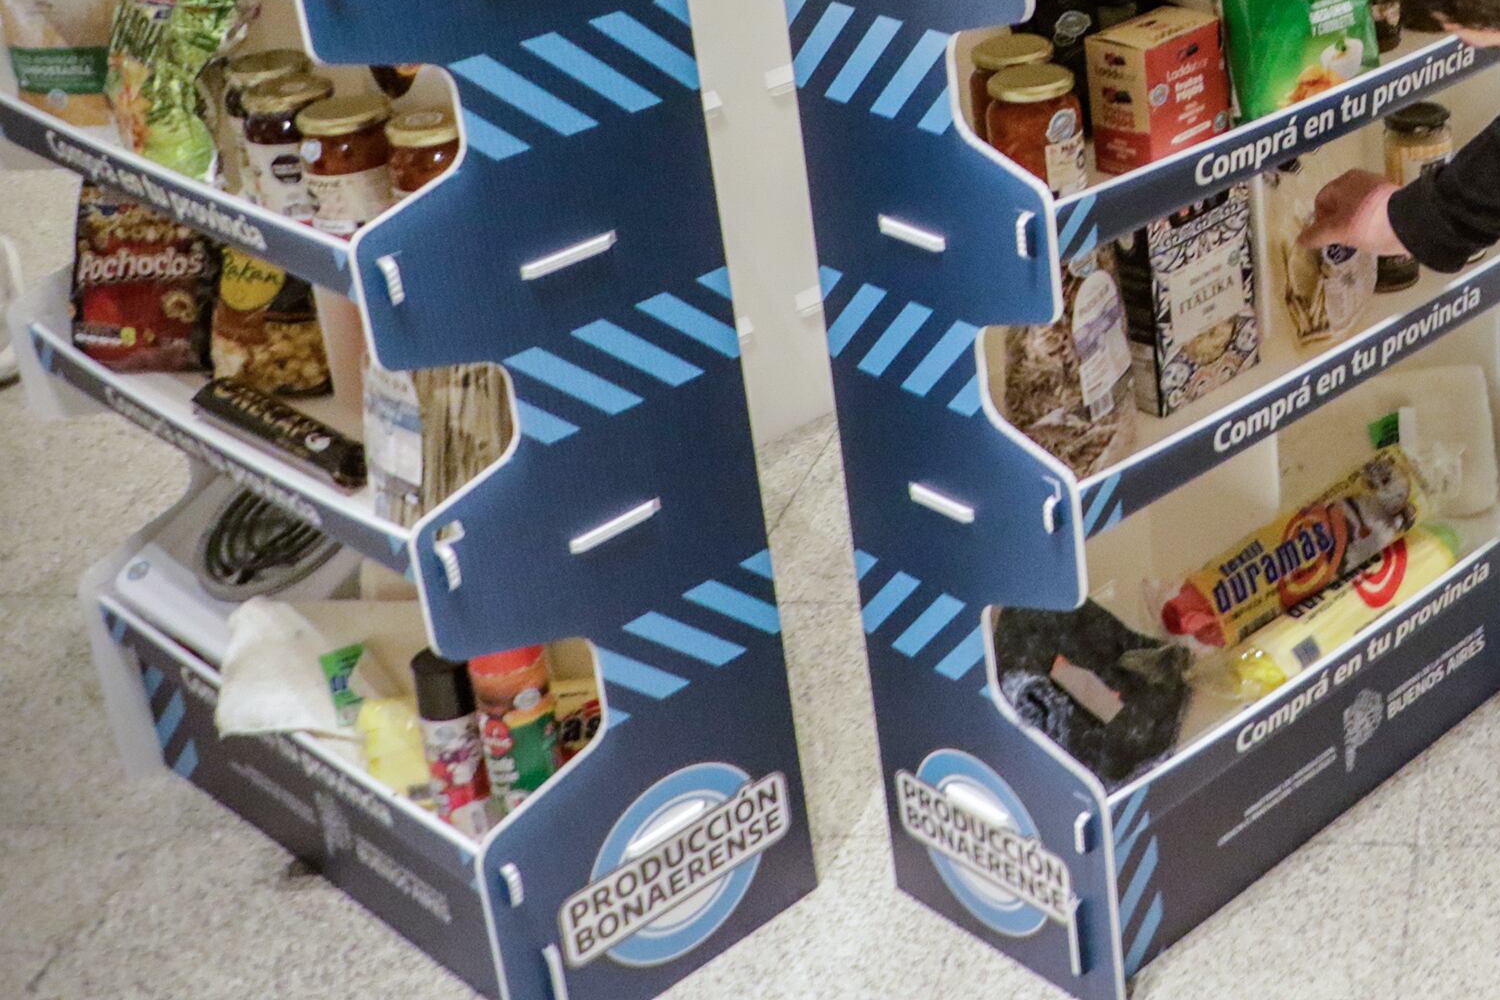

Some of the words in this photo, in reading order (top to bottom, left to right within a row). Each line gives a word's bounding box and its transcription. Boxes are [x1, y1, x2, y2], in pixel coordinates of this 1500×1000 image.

[1194, 120, 1298, 187] Comprá
[1304, 109, 1334, 139] en
[1340, 92, 1368, 122] tu
[1374, 43, 1476, 115] provincia
[168, 189, 268, 251] provincia
[1213, 381, 1311, 454] Comprá
[1315, 362, 1345, 395] en
[1350, 343, 1378, 374] tu
[1382, 287, 1481, 367] provincia
[1236, 671, 1328, 753] Comprá
[1333, 651, 1362, 689] en
[1366, 632, 1392, 665] tu
[1394, 560, 1490, 649] provincia
[1387, 664, 1445, 720] BUENOS
[1446, 640, 1486, 676] AIRES
[570, 780, 778, 929] PRODUCCIÓN
[575, 806, 783, 954] BONAERENSE
[904, 780, 1063, 888] PRODUCCIÓN
[906, 805, 1061, 911] BONAERENSE
